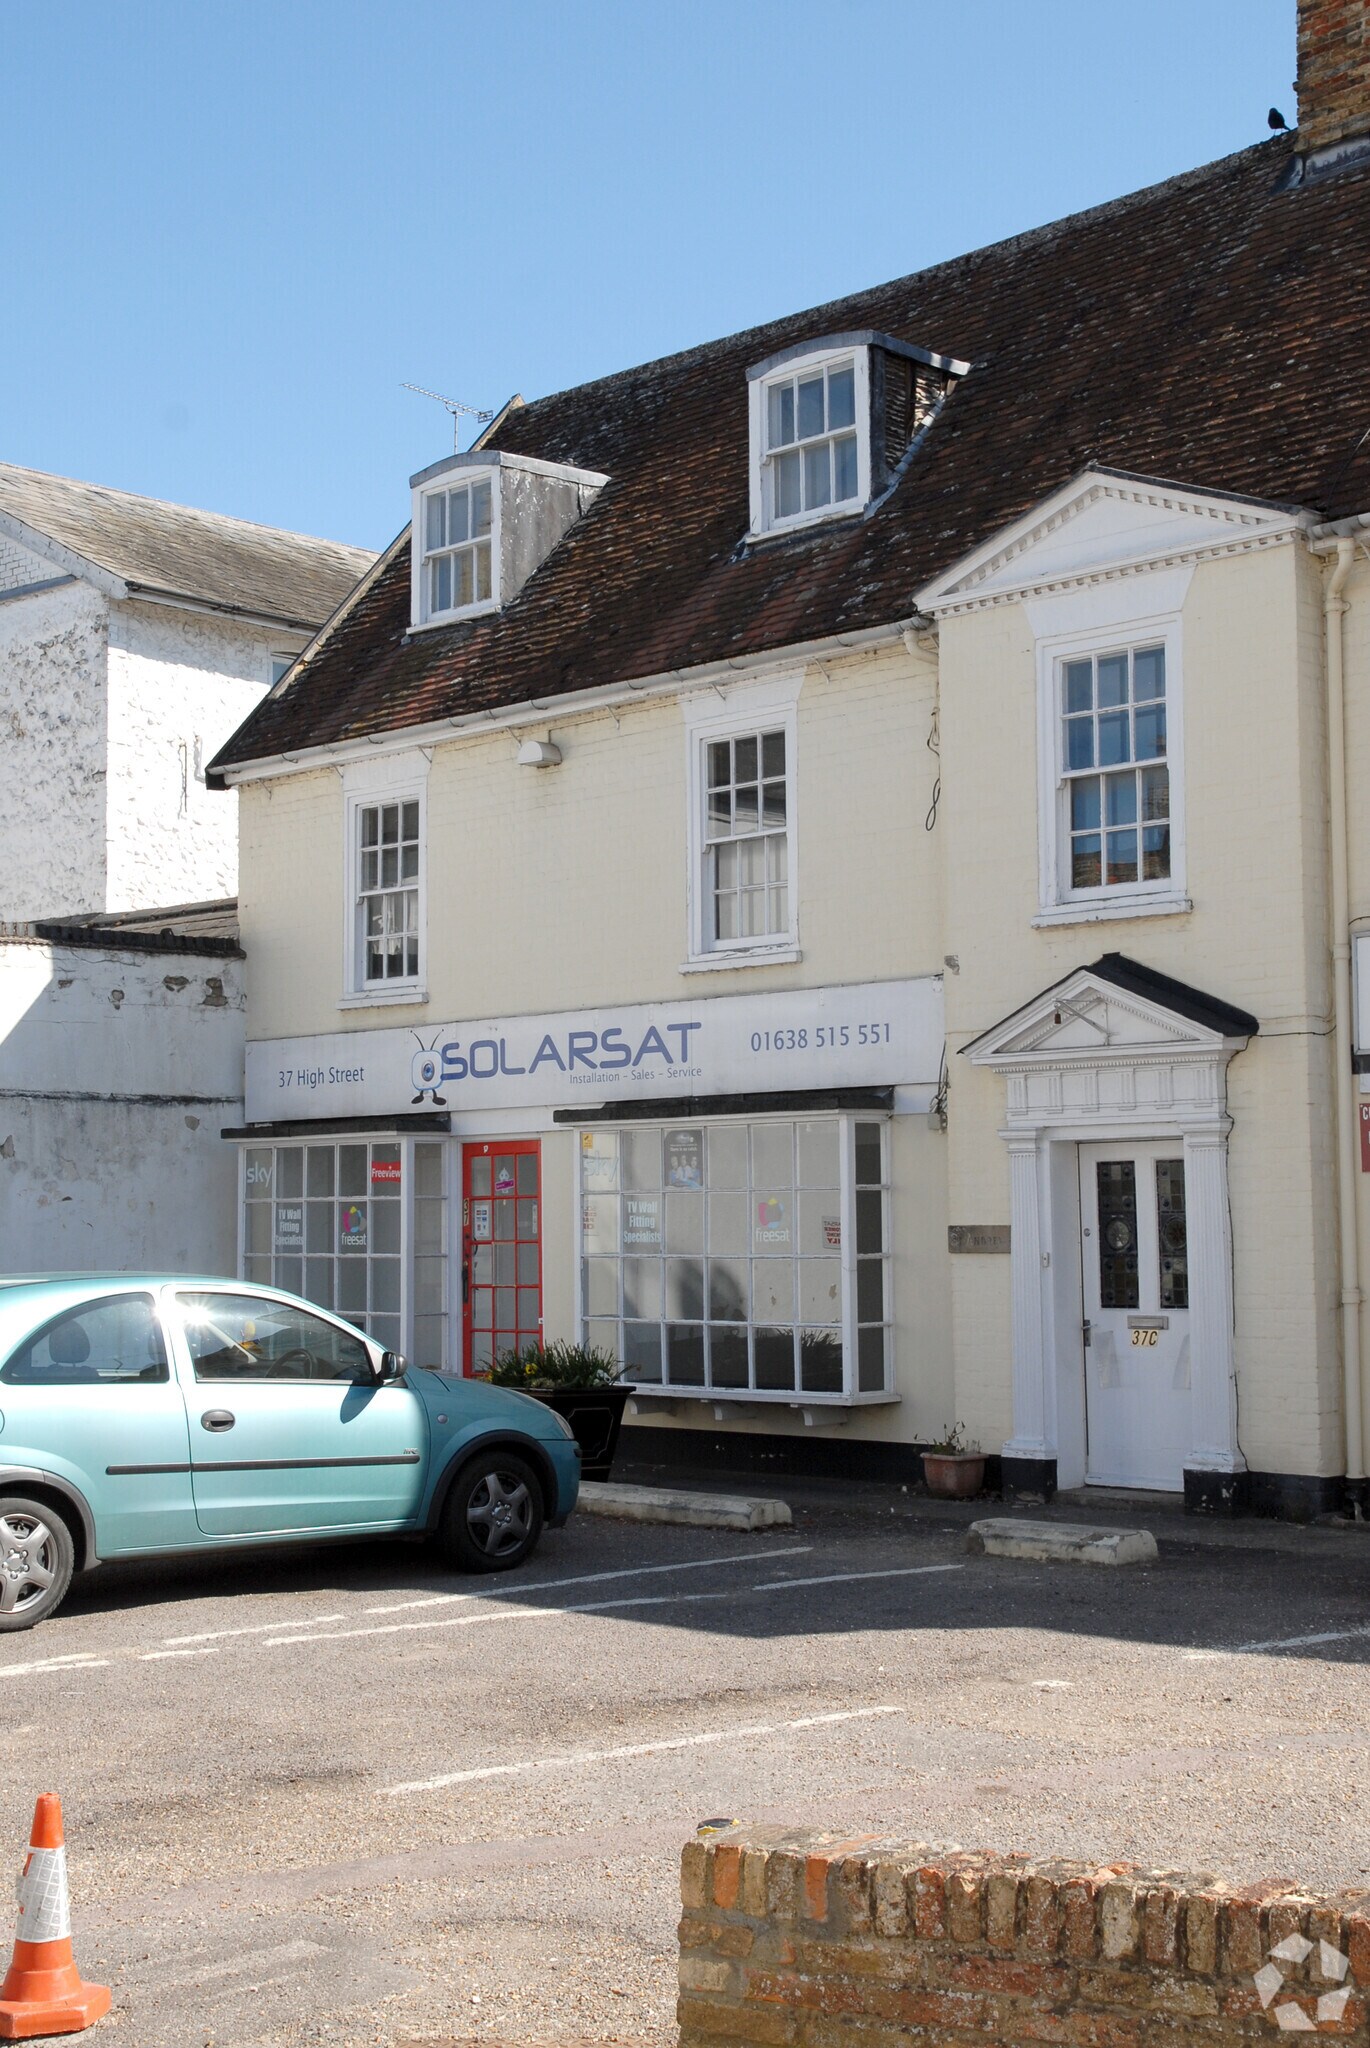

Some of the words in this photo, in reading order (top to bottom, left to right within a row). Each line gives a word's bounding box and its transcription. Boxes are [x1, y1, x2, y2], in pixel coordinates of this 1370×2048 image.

[751, 1029, 808, 1052] 01638
[815, 1026, 850, 1048] 515
[858, 1023, 890, 1045] 551
[441, 1022, 702, 1081] SOLARSAT
[278, 1071, 294, 1088] 37
[298, 1067, 325, 1090] High
[329, 1066, 365, 1084] Street
[569, 1072, 620, 1084] Installation
[631, 1069, 655, 1081] Sales
[667, 1066, 702, 1079] Service
[246, 1161, 273, 1188] sky
[372, 1165, 401, 1178] Freeview
[583, 1152, 619, 1183] sky
[278, 1209, 287, 1219] TV
[287, 1208, 302, 1219] Wall
[627, 1202, 638, 1213] TV
[639, 1200, 658, 1213] Wall
[279, 1222, 300, 1233] Fitting
[629, 1215, 656, 1229] Fitting
[275, 1235, 304, 1246] Specialists
[341, 1233, 367, 1245] freesat
[623, 1230, 662, 1244] Specialists
[756, 1227, 790, 1242] freesat
[1131, 1330, 1158, 1346] 37C
